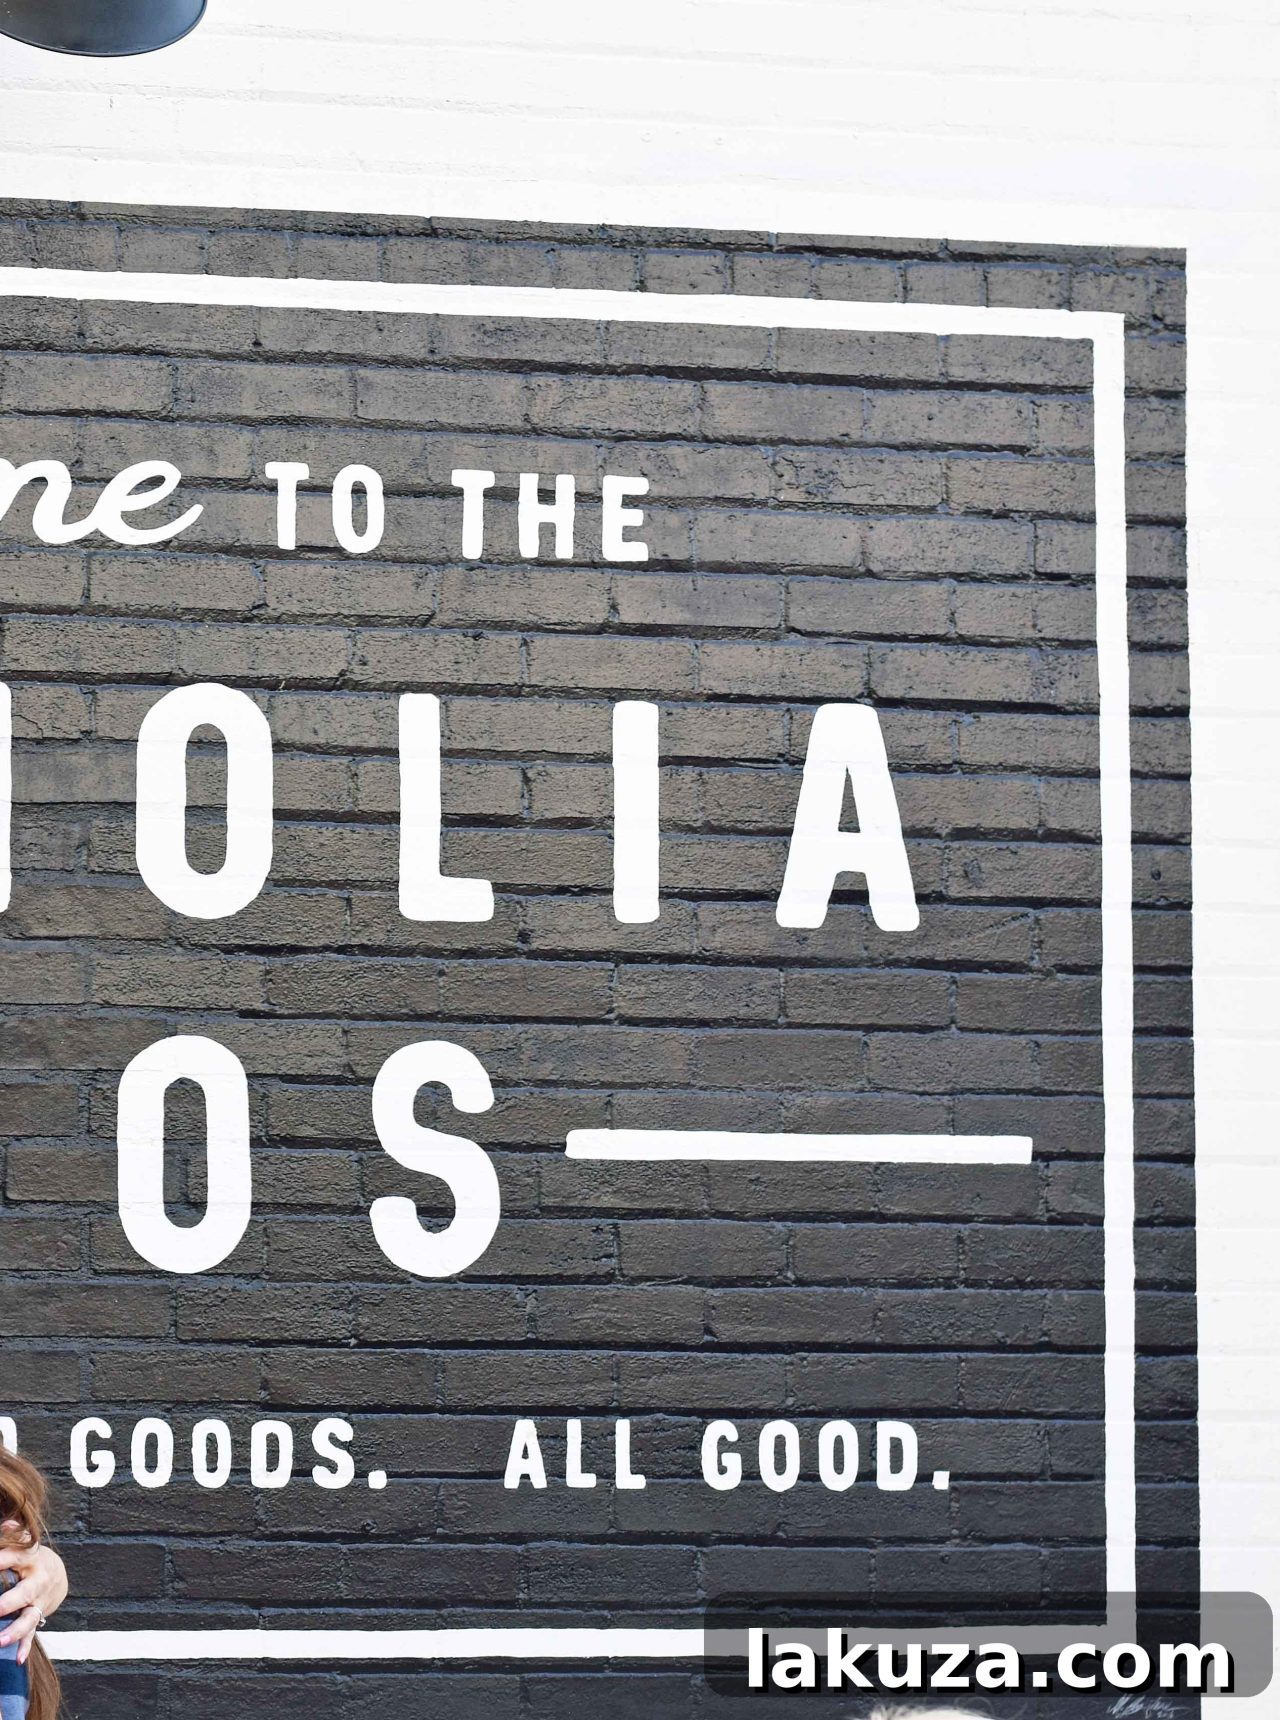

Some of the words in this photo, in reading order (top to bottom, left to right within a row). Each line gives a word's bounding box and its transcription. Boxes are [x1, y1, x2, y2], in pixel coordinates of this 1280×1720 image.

[264, 461, 386, 554] TO
[450, 468, 650, 562] THE
[69, 1416, 388, 1490] GOODS.
[503, 1418, 647, 1490] ALL
[701, 1419, 950, 1492] GOOD.
